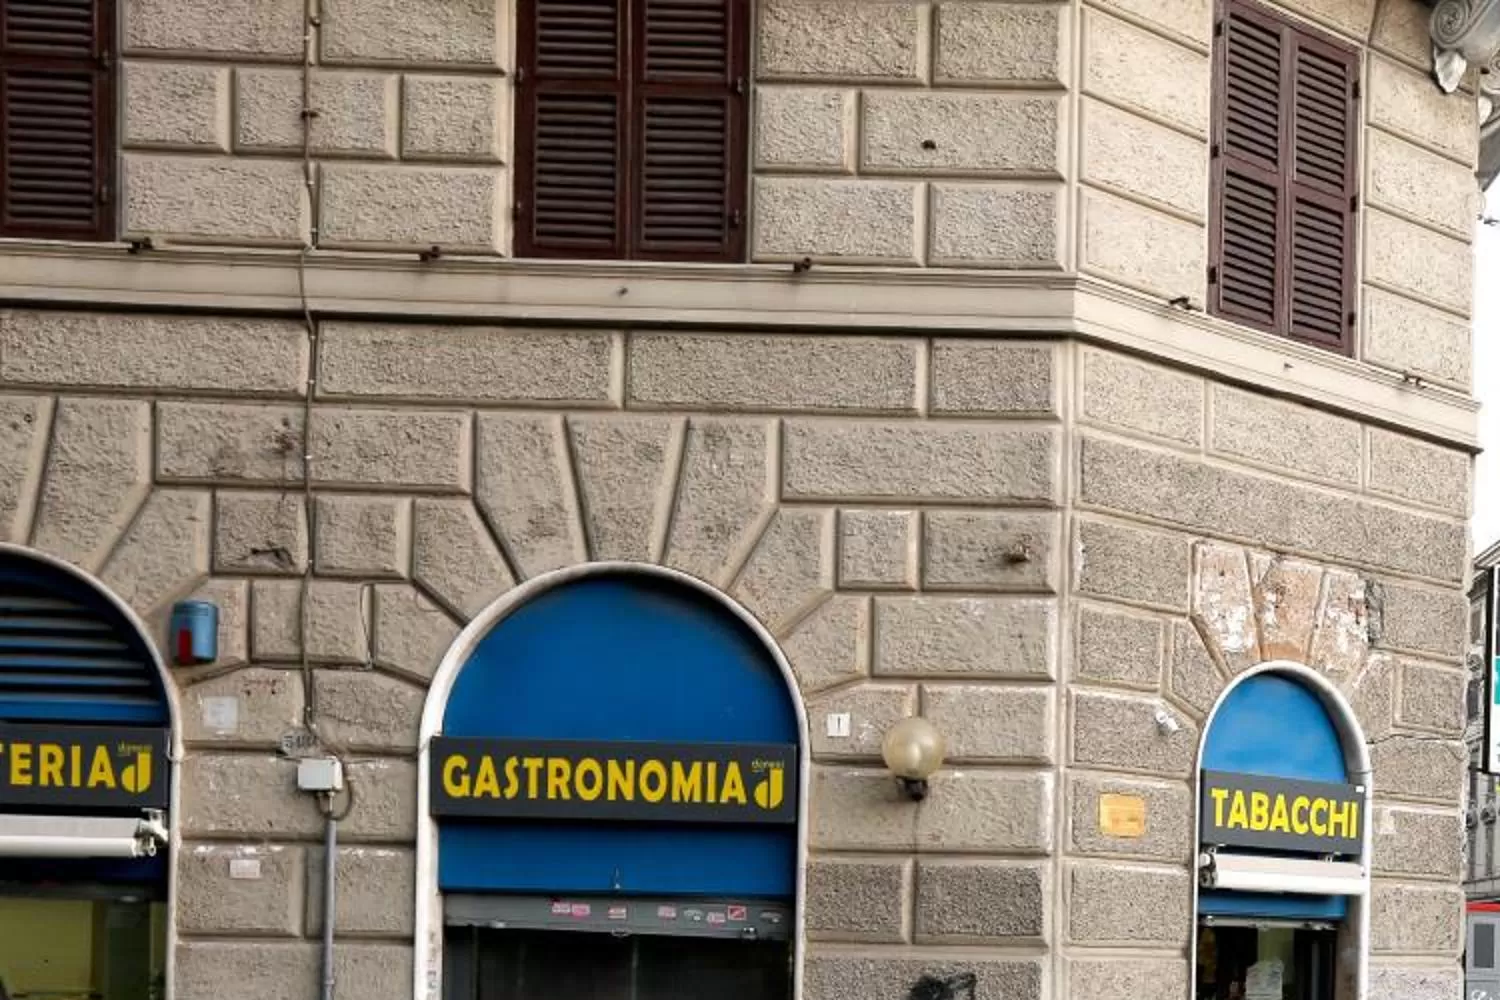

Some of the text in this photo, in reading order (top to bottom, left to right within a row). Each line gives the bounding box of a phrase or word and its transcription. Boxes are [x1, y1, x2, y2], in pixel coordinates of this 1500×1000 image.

[0, 743, 116, 788] ERIA
[443, 755, 747, 805] GASTRONOMIA
[1211, 788, 1358, 839] TABACCHI
